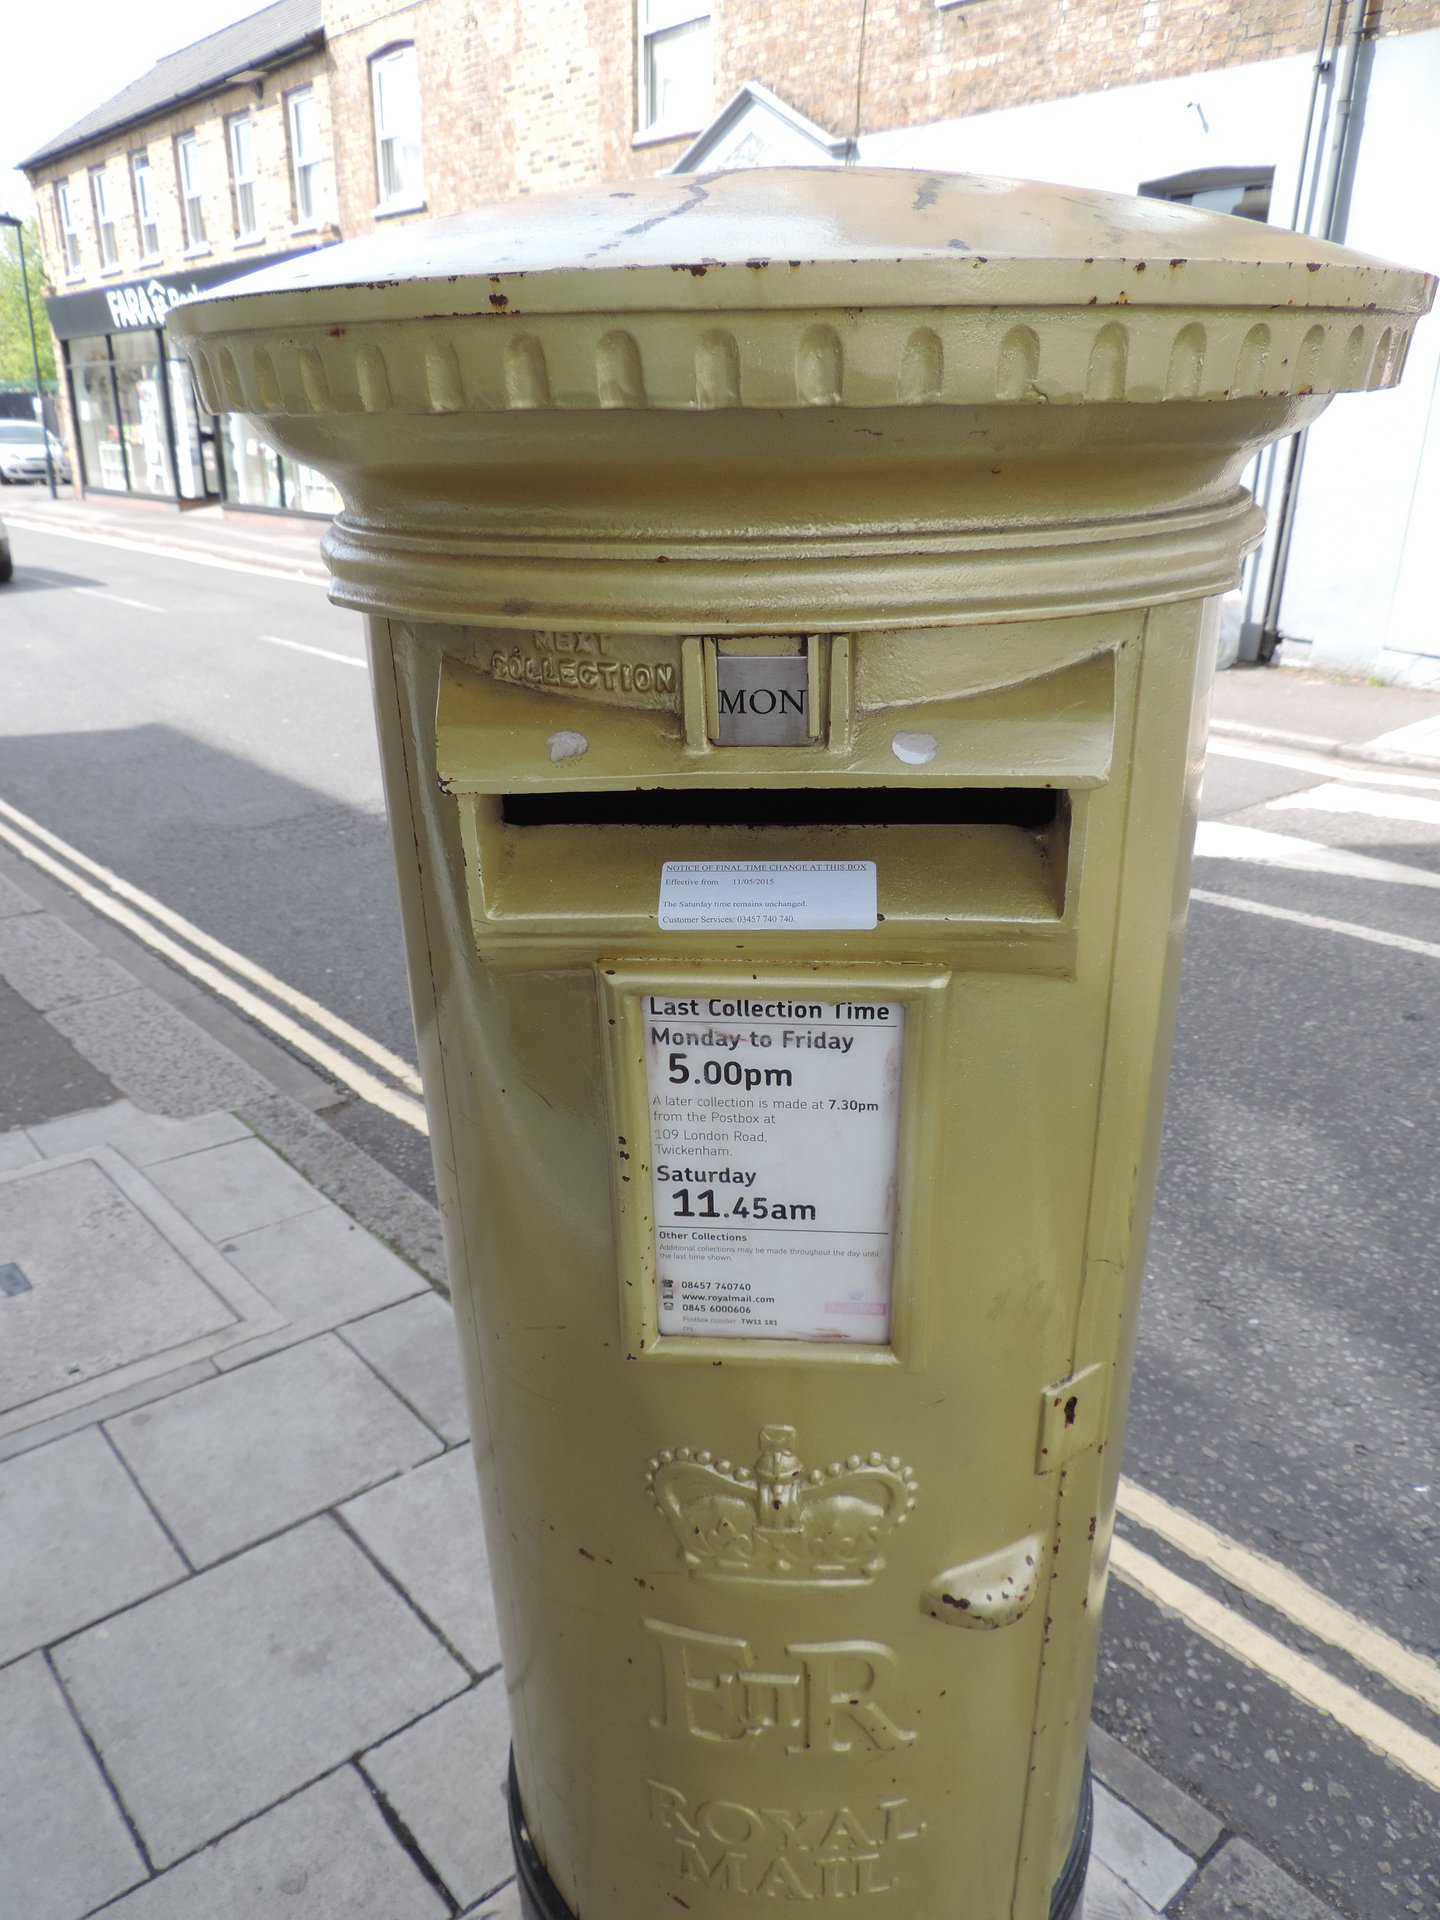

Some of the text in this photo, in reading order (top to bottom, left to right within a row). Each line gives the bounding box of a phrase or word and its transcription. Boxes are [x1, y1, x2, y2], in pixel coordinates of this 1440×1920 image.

[106, 286, 157, 328] FARA
[491, 650, 677, 694] COLLECTION
[718, 689, 808, 716] MON
[666, 864, 699, 872] NOTICE
[701, 864, 715, 872] OF
[716, 864, 743, 872] FINAL
[744, 864, 767, 872] TIME
[769, 864, 808, 872] CHANGE
[665, 878, 775, 886] Effective from 11/05/2015
[679, 901, 712, 909] Saturday
[764, 901, 808, 909] unchanged.
[662, 916, 699, 924] Customer
[701, 916, 735, 924] Services:
[779, 915, 796, 923] 740.
[650, 997, 890, 1021] Last Collection Time
[651, 1027, 854, 1053] Monday to Friday
[668, 1053, 793, 1091] 5.00pm
[652, 1096, 879, 1113] A later collection is made at 7.30pm
[653, 1111, 776, 1124] from the Postbox at
[655, 1129, 768, 1143] 109 London Road,
[656, 1144, 733, 1157] Twickenham.
[656, 1165, 757, 1187] Saturday
[672, 1188, 817, 1221] 11.45am
[659, 1231, 748, 1242] Other Collections
[659, 1244, 880, 1258] Additional collections may be made throughout the day until
[659, 1252, 672, 1260] the
[688, 1253, 705, 1261] time
[707, 1253, 733, 1261] shown.
[681, 1281, 751, 1291] 08457 740740
[681, 1293, 775, 1303] www.royalmail.com
[682, 1303, 706, 1312] 0845
[682, 1315, 708, 1323] Postbox
[648, 1778, 927, 1850] ROYAL
[674, 1837, 899, 1900] MAIL
